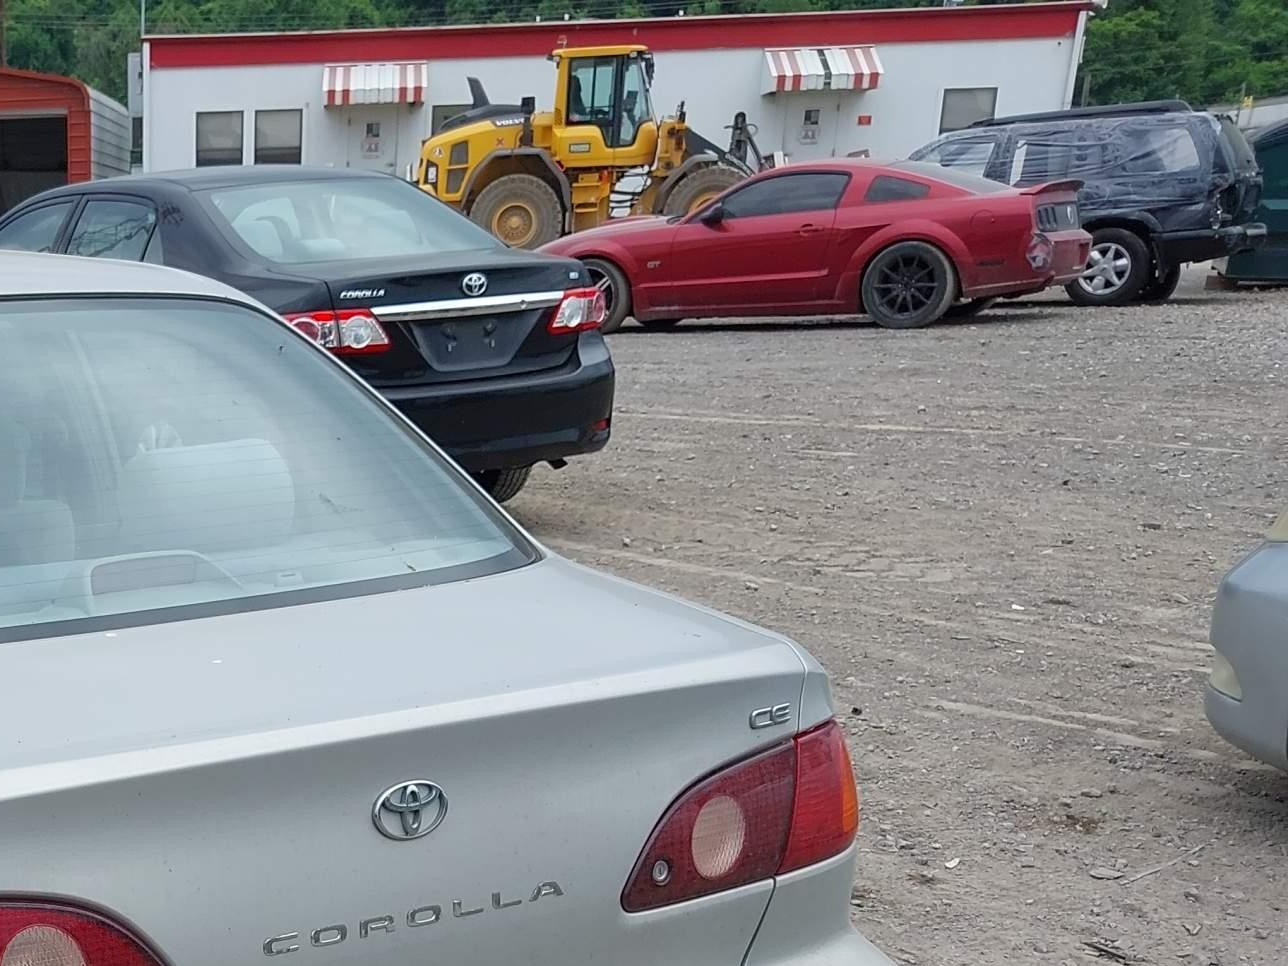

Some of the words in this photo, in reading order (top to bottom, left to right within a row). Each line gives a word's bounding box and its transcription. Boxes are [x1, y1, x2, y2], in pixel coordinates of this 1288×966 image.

[647, 260, 661, 269] GT
[339, 288, 385, 299] COROLLA
[749, 702, 792, 730] CE
[262, 880, 564, 957] COROLLA
